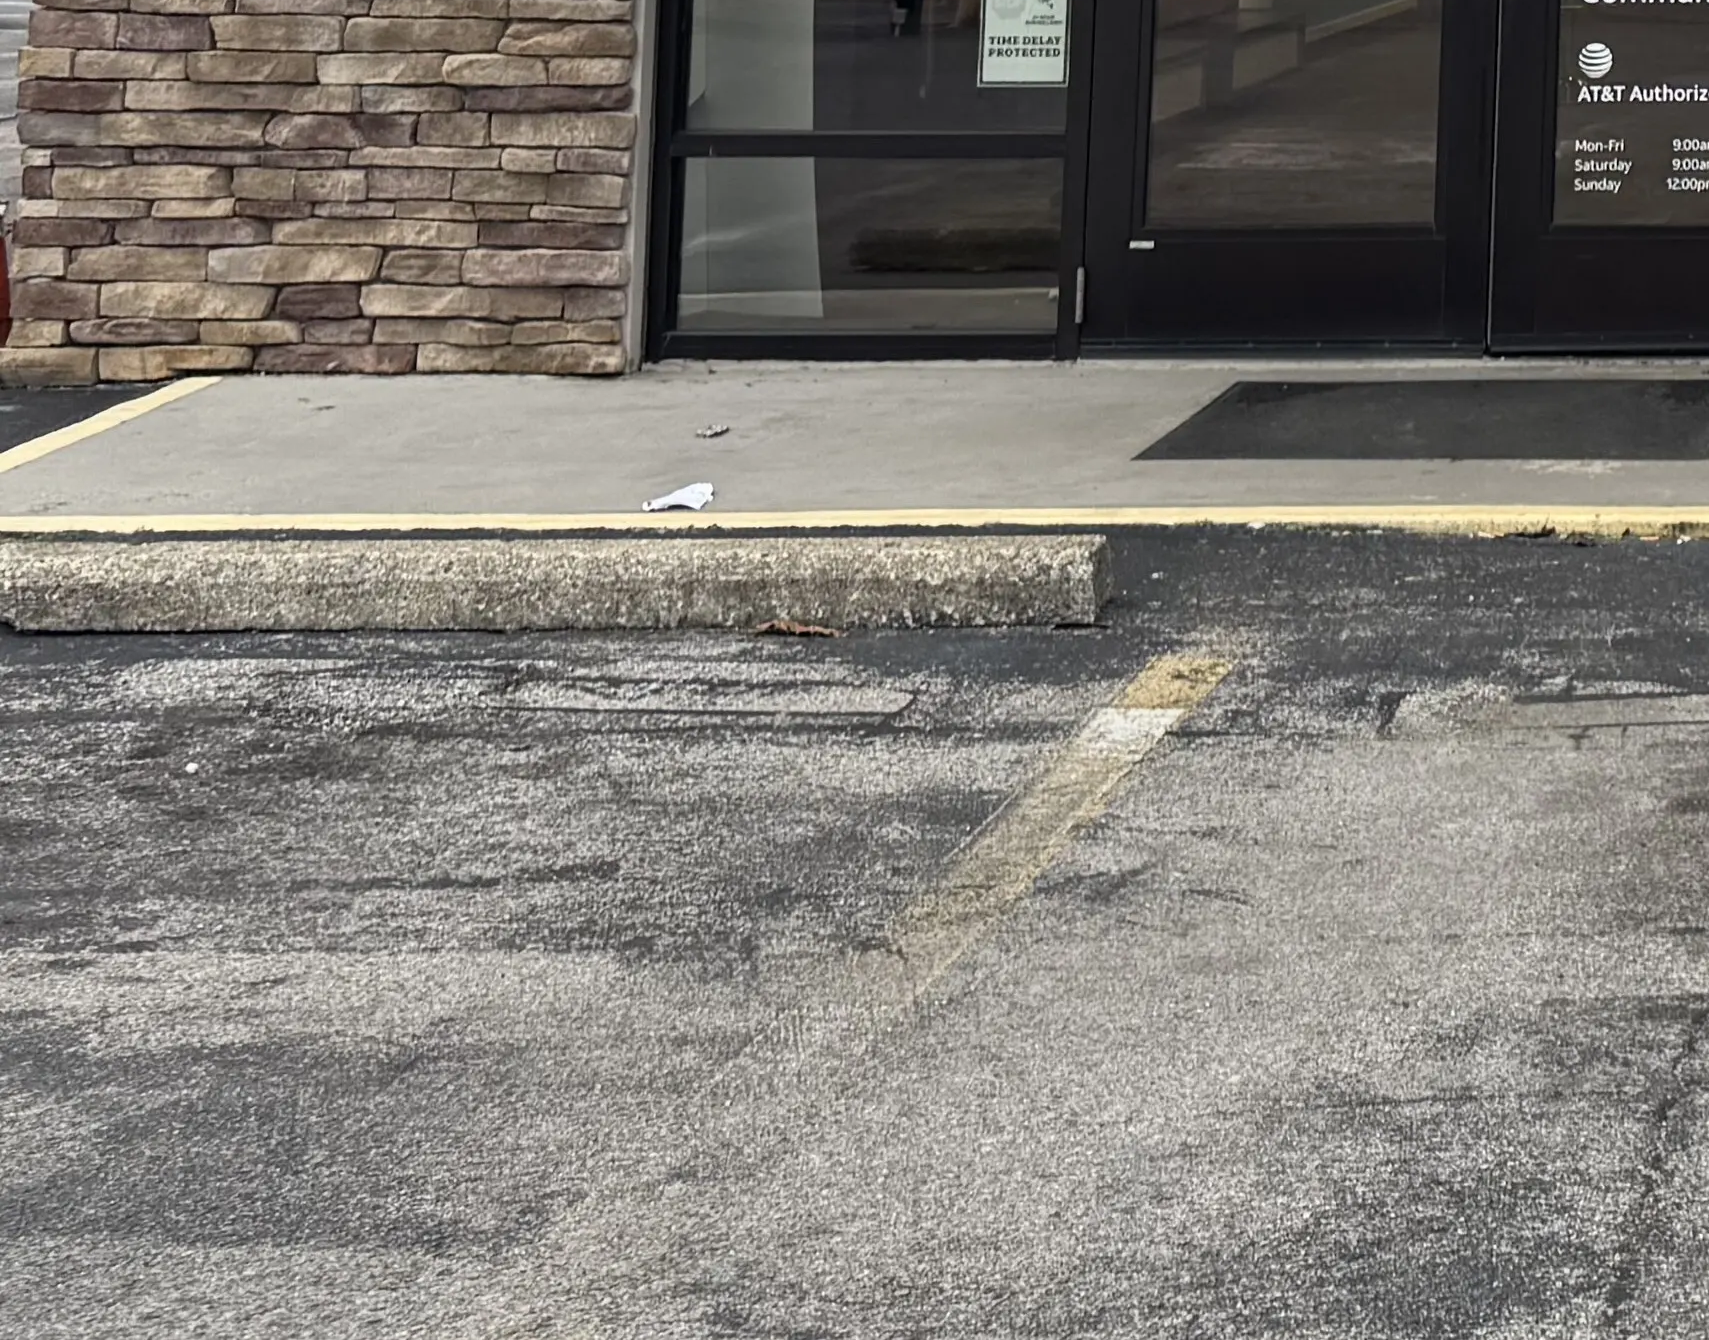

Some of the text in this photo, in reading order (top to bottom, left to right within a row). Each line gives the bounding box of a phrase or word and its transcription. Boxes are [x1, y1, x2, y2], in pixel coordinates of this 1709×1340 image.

[988, 36, 1062, 46] TIME DELAY
[988, 48, 1061, 58] PROTECTED
[1578, 85, 1626, 102] AT&T
[1575, 139, 1625, 152] Mon-Fri
[1575, 158, 1632, 174] Saturday
[1574, 178, 1621, 194] Sunday
